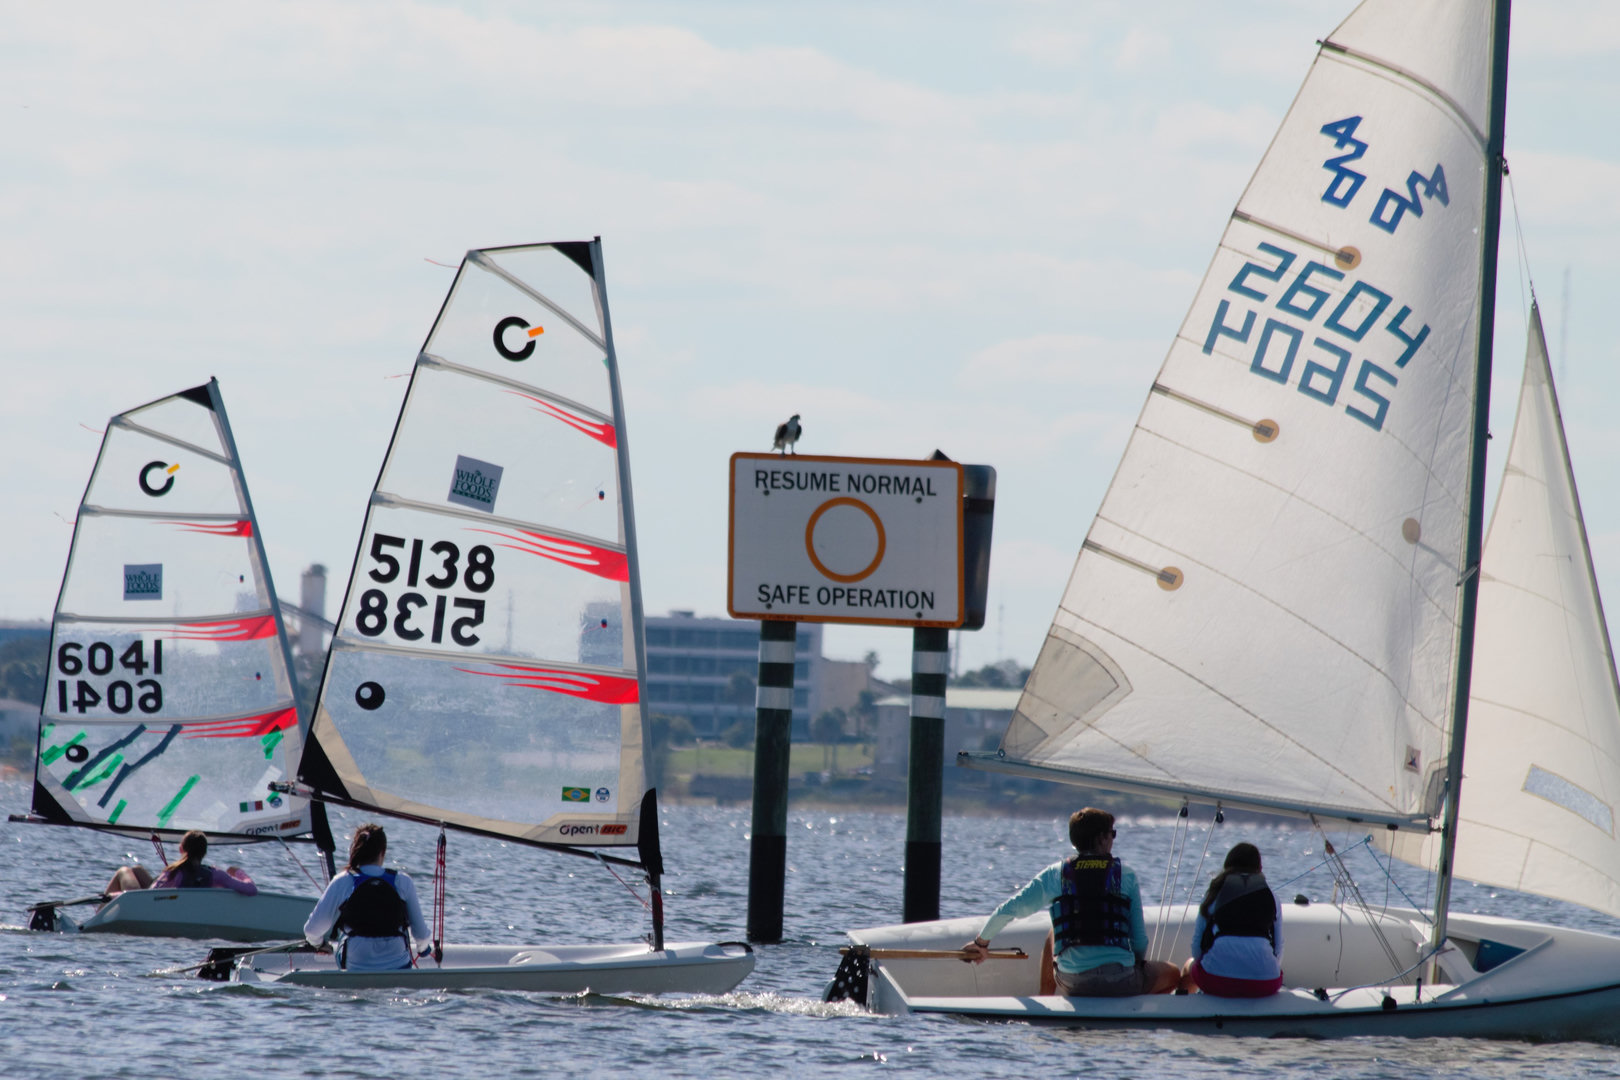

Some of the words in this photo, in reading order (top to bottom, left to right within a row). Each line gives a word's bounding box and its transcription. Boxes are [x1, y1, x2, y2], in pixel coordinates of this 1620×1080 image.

[1320, 115, 1369, 209] 420
[1228, 242, 1431, 369] 2604
[454, 480, 493, 499] FOODS
[456, 469, 496, 489] WHOLE
[755, 470, 840, 492] RESUME
[848, 474, 937, 496] NORMAL
[368, 533, 495, 593] 5138
[758, 584, 810, 604] SAFE
[817, 587, 934, 610] OPERATION
[58, 640, 162, 676] 6041
